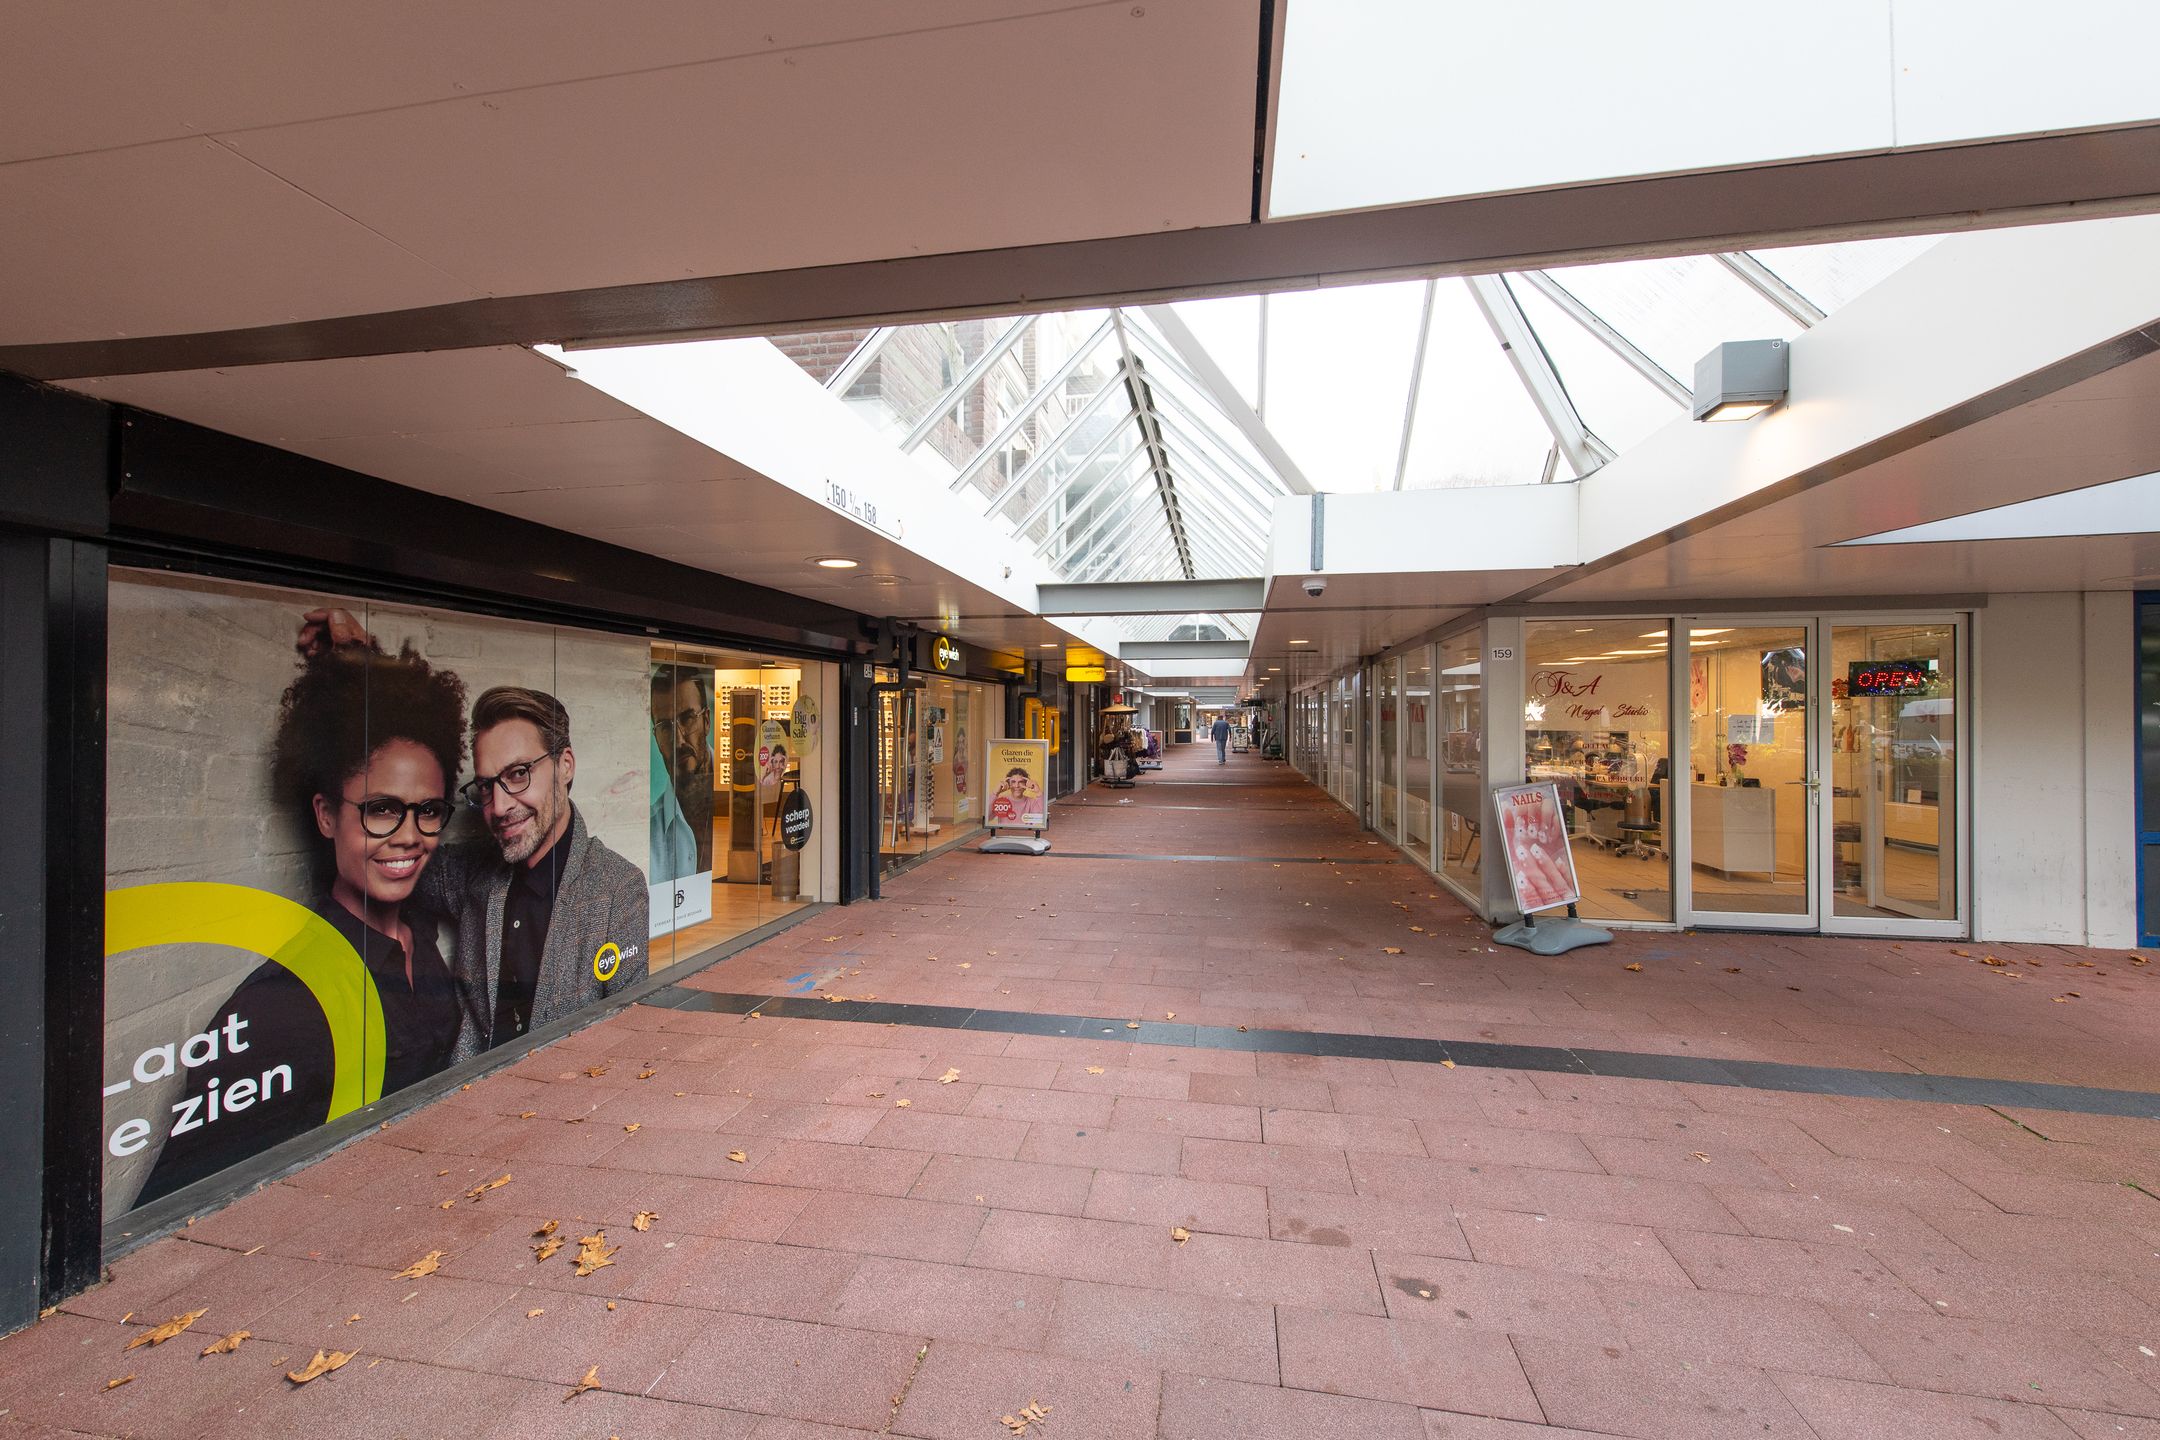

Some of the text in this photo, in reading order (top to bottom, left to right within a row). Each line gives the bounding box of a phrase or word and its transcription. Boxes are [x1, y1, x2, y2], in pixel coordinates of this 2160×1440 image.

[832, 483, 846, 508] 150
[864, 502, 876, 525] 158
[1493, 649, 1512, 658] 159
[1858, 672, 1922, 687] OPEN
[795, 711, 807, 727] Big
[1565, 703, 1649, 721] Nagel Studio
[1511, 792, 1543, 806] NAILS
[785, 808, 810, 823] scherp
[786, 819, 810, 834] voordeel
[598, 944, 639, 970] eyewish
[170, 1063, 293, 1138] zien
